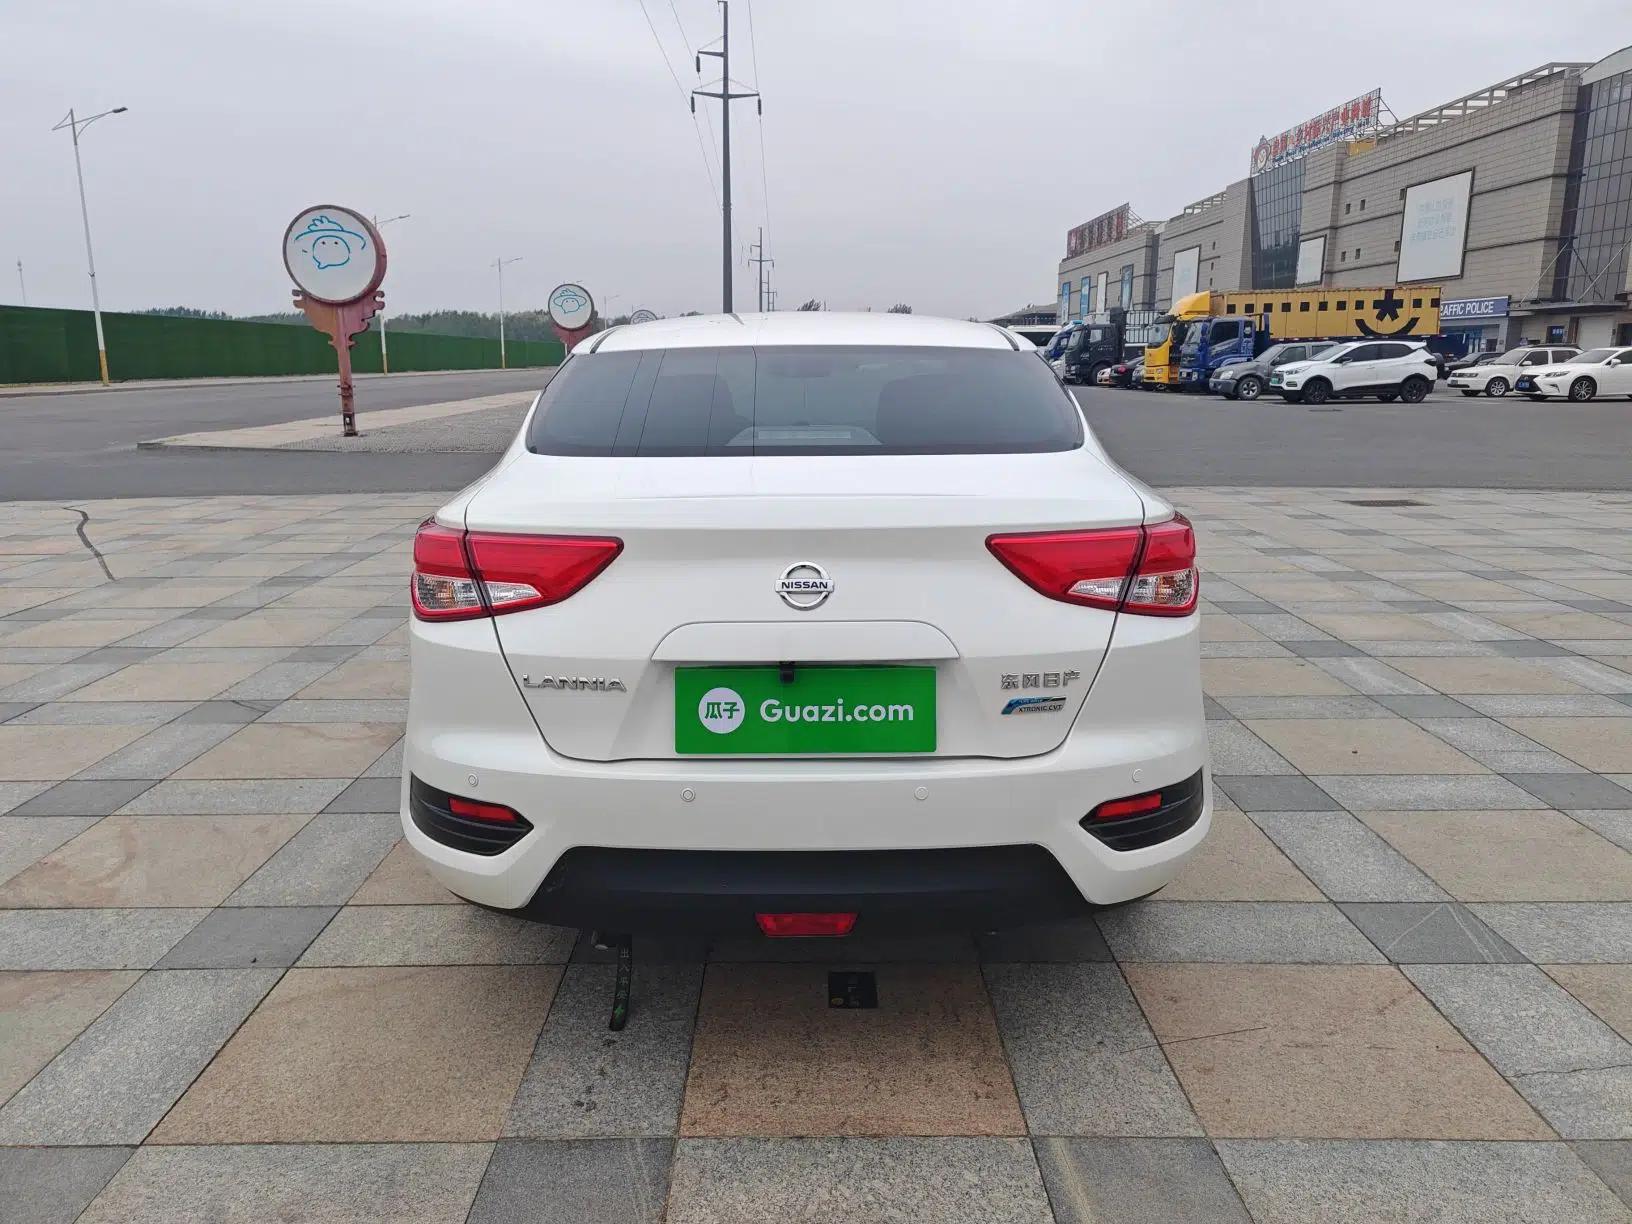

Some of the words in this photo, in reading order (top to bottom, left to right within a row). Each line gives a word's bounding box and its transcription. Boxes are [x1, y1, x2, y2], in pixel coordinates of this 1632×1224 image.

[1465, 301, 1494, 315] POLICE
[781, 581, 828, 589] NISSAN
[522, 674, 627, 693] LANNIA
[1001, 669, 1081, 689] 东风日产
[704, 702, 740, 719] 瓜子
[759, 697, 914, 723] Guazi.com
